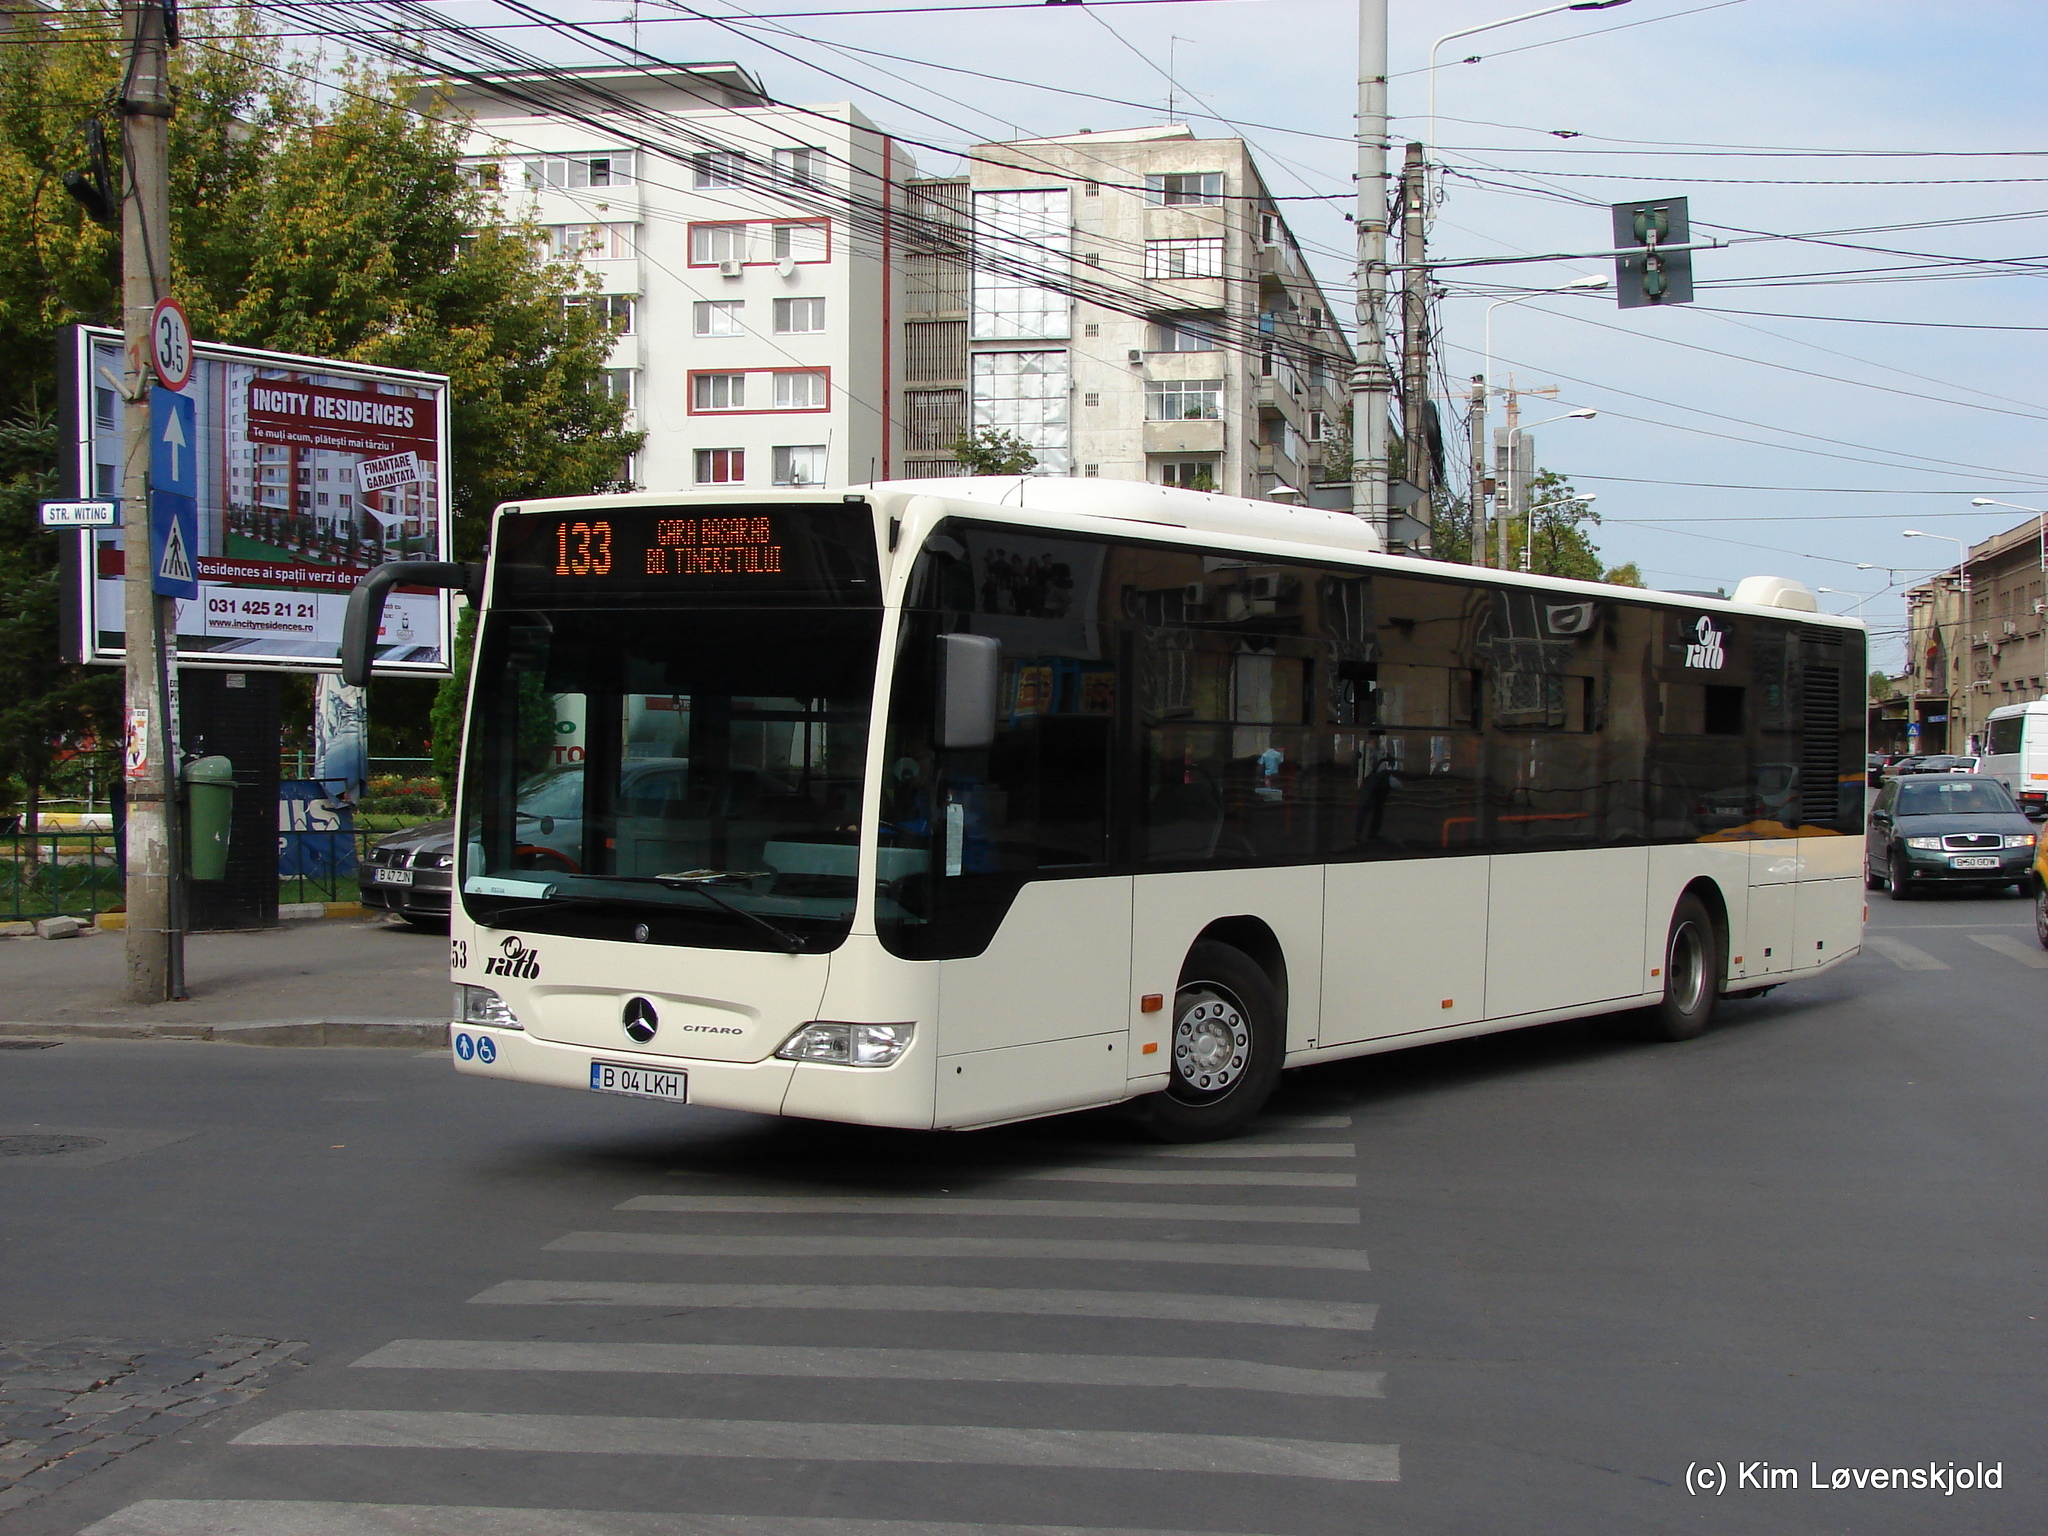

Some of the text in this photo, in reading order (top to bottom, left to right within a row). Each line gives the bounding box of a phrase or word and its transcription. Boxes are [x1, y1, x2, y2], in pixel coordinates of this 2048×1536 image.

[253, 387, 414, 428] INCITY RESIDENCES
[253, 426, 264, 437] Te
[265, 429, 286, 442] muți
[287, 433, 313, 444] acum,
[348, 438, 364, 448] mai
[365, 439, 390, 451] târziu
[49, 507, 107, 520] STR. WITING
[556, 517, 770, 575] 133 GARA BASARAB
[646, 546, 782, 574] BD. TINERETULUI
[197, 561, 260, 578] Residences
[262, 566, 272, 579] ai
[275, 569, 306, 584] spații
[308, 571, 336, 584] verzi
[338, 573, 351, 584] de
[208, 599, 314, 618] 031 425 21 21
[208, 619, 314, 632] www.incityresidences.ro
[1956, 858, 1962, 867] B
[379, 868, 411, 883] B 47 ZJN
[683, 1025, 744, 1035] CITARO
[604, 1068, 615, 1087] B
[621, 1071, 640, 1091] 04
[644, 1073, 678, 1096] LKH
